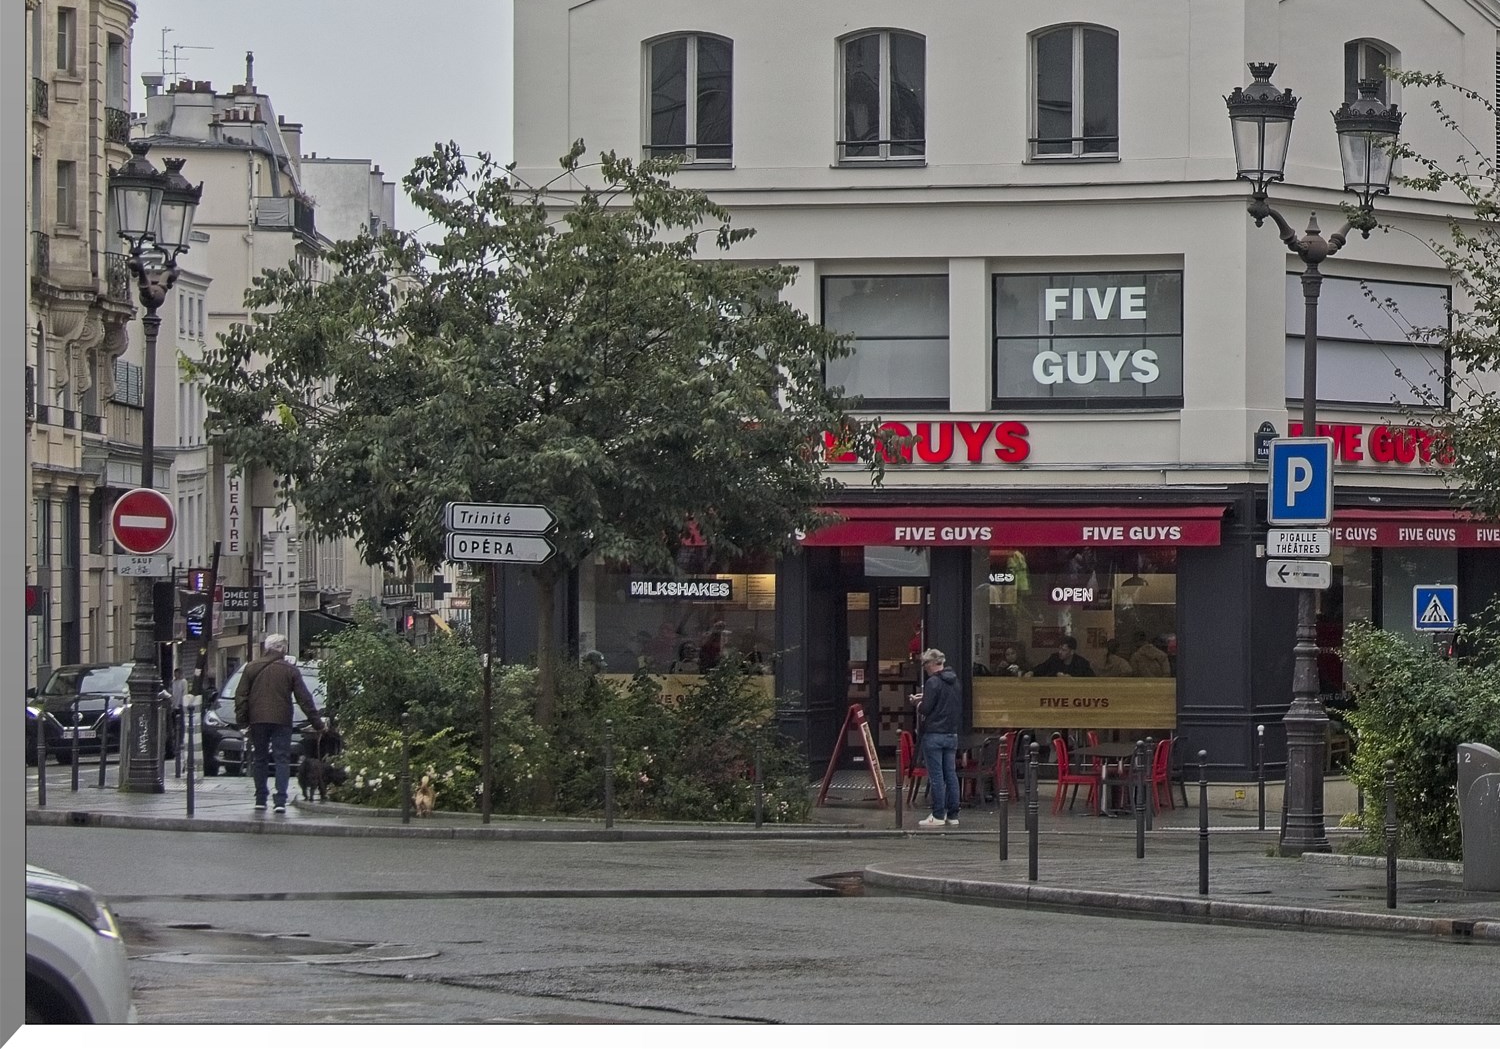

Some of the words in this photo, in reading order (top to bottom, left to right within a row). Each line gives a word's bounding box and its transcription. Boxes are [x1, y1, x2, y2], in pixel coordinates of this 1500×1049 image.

[1045, 287, 1147, 320] FIVE
[1032, 349, 1160, 384] GUYS
[872, 421, 1031, 464] GUYS
[1286, 456, 1313, 507] P
[460, 511, 511, 525] Trinité
[894, 527, 936, 541] FIVE
[940, 526, 993, 541] GUYS
[1082, 527, 1124, 541] FIVE
[1129, 526, 1182, 540] GUYS
[1280, 533, 1317, 542] PIGALLE
[1345, 528, 1378, 541] GUYS
[1399, 528, 1423, 541] FIVE
[1426, 528, 1456, 542] GUYS
[1476, 528, 1500, 541] FIVE
[458, 539, 514, 555] OPÉRA
[1276, 543, 1321, 554] THÉÂTRES
[631, 581, 730, 597] MILKSHAKES
[1051, 587, 1094, 602] OPEN
[1040, 698, 1069, 708] FIVE
[1072, 698, 1110, 708] GUYS
[1465, 753, 1471, 763] 2
